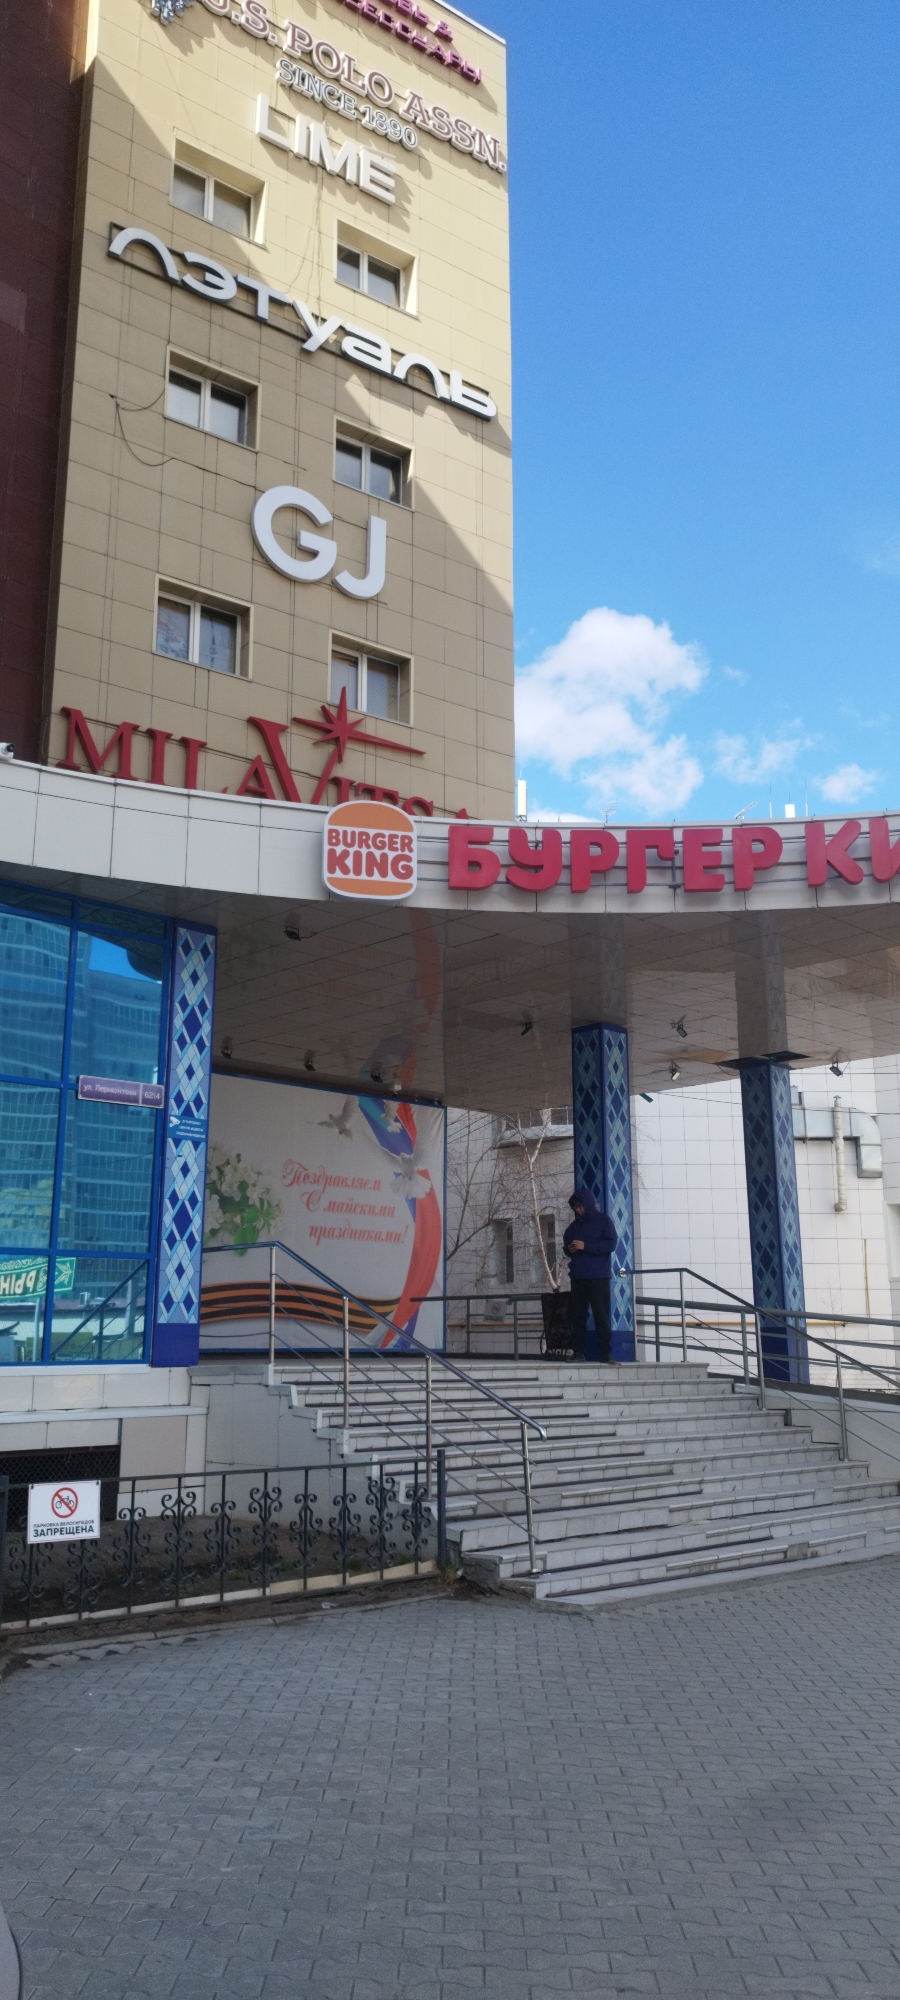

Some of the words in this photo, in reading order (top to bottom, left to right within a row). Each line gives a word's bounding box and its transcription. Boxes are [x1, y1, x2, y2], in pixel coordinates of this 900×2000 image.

[276, 59, 357, 118] SINCE
[362, 105, 418, 150] 1890
[283, 19, 394, 107] POLO
[402, 88, 507, 173] ASSN.
[256, 93, 396, 205] LIME
[251, 486, 387, 599] GJ
[327, 828, 414, 853] BURGER
[326, 849, 414, 880] KING
[448, 826, 784, 894] БУРГЕР
[83, 1084, 93, 1092] ул.
[95, 1084, 137, 1096] Лермонтова
[281, 1159, 382, 1193] Поздравляем
[300, 1189, 322, 1212] С
[324, 1197, 395, 1218] майскими
[308, 1219, 409, 1246] праздниками!
[33, 1525, 94, 1538] ЗАПРЕЩЕНА
